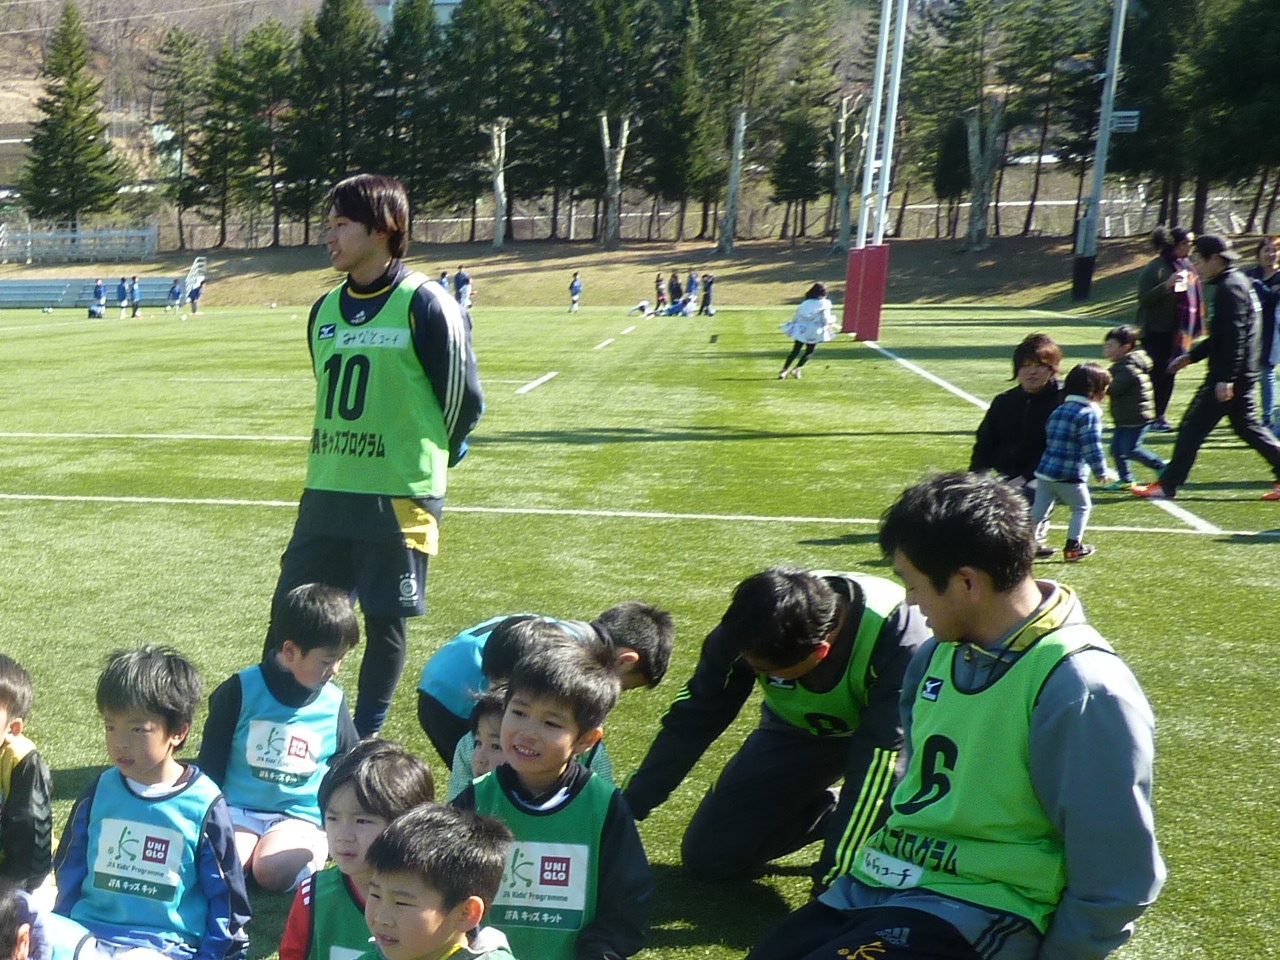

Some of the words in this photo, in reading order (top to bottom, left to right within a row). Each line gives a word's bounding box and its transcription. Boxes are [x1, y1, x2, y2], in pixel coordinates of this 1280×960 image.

[324, 353, 370, 421] 10
[894, 734, 959, 815] 6
[147, 841, 166, 851] UNI
[145, 850, 164, 859] QLO
[131, 865, 164, 877] Programme
[544, 862, 567, 871] UNI
[543, 871, 566, 881] QLO
[529, 892, 568, 902] Programme
[521, 911, 540, 922] キッズ
[541, 913, 562, 923] キット
